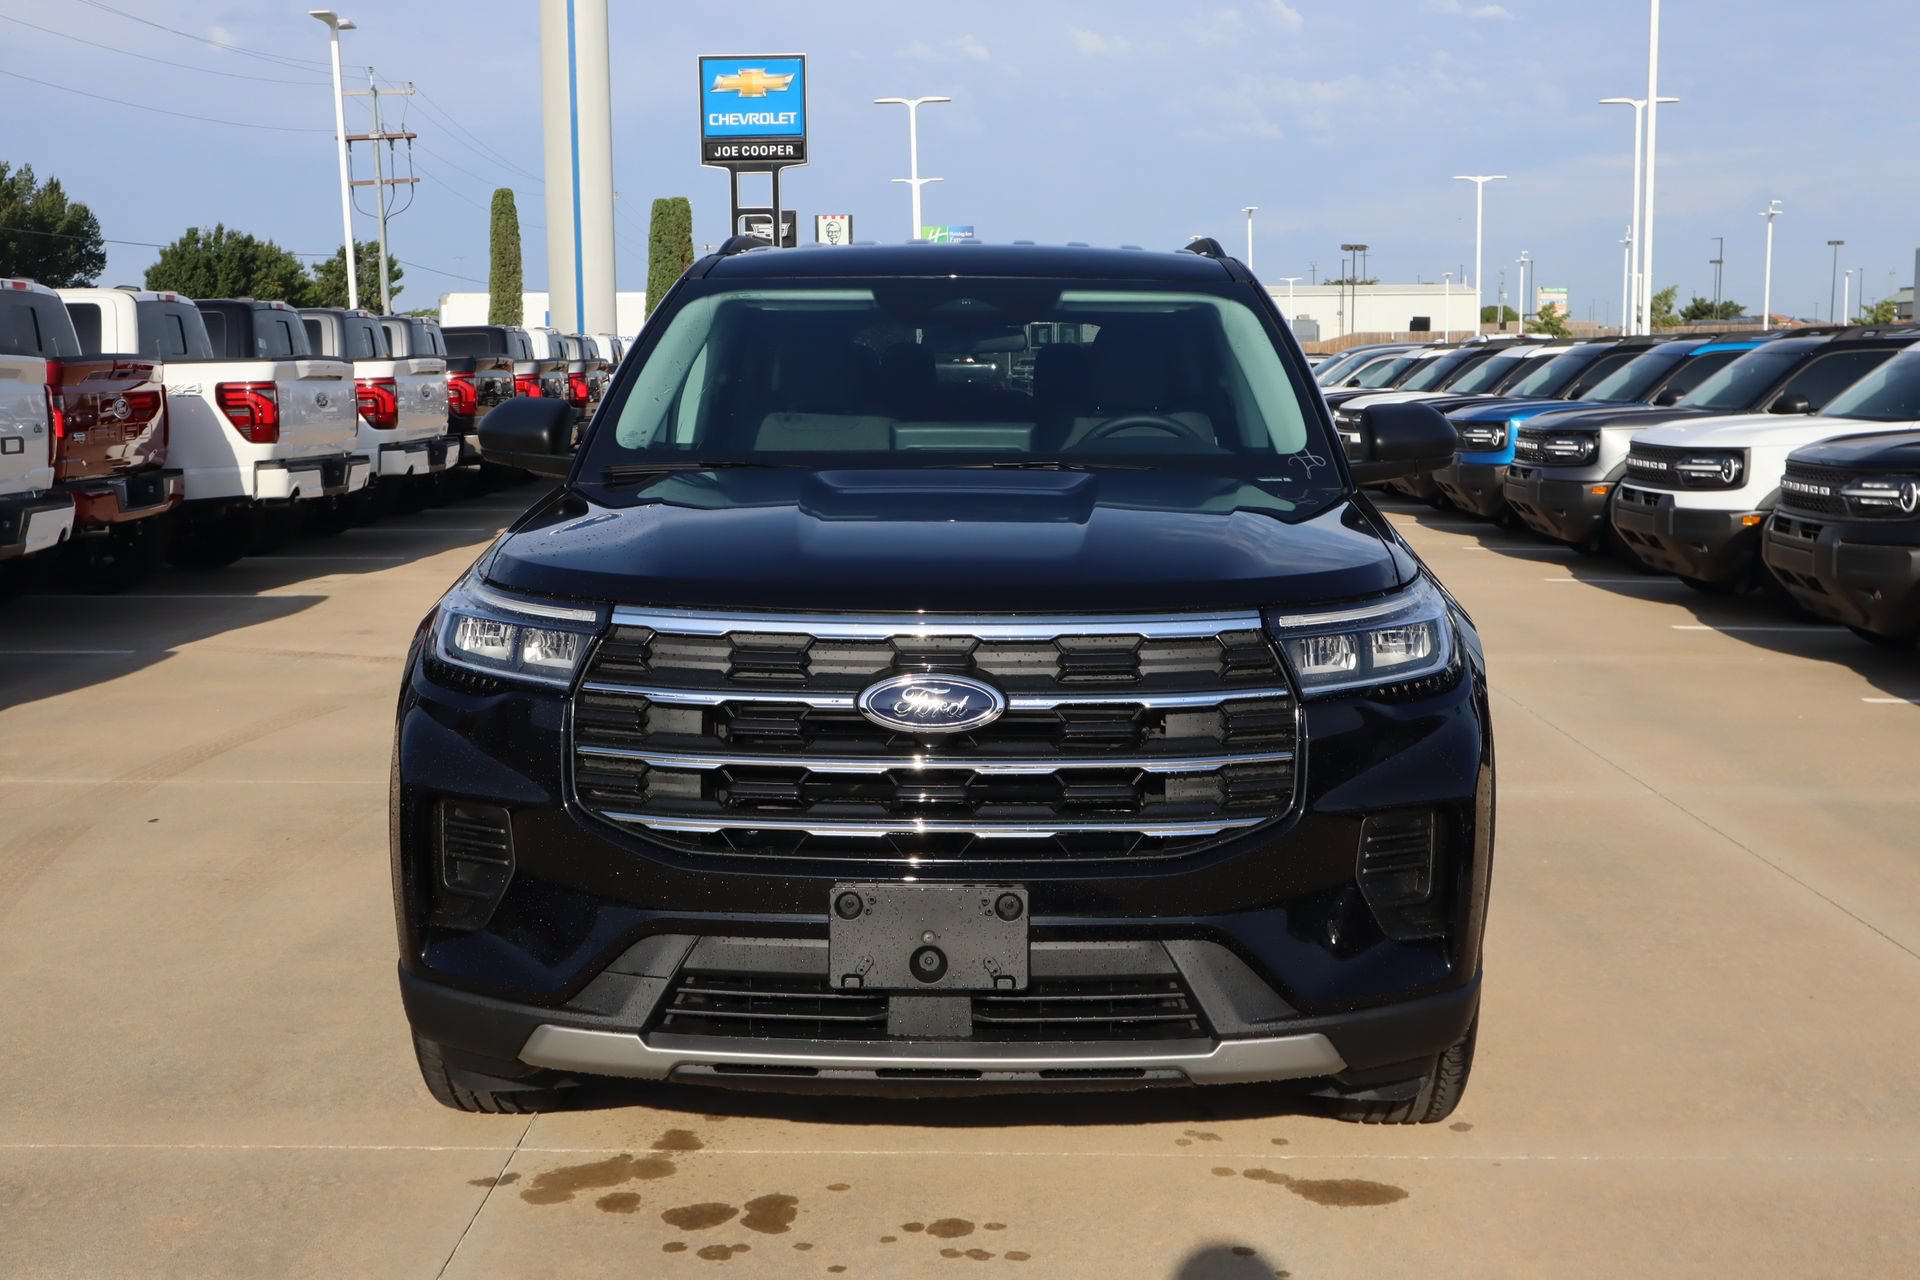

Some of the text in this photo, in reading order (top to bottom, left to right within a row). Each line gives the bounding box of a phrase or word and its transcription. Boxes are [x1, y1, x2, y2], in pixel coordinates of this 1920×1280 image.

[709, 112, 797, 126] CHEVROLET
[714, 145, 794, 157] JOE COOPER
[167, 384, 203, 395] X4
[894, 686, 970, 718] Ford
